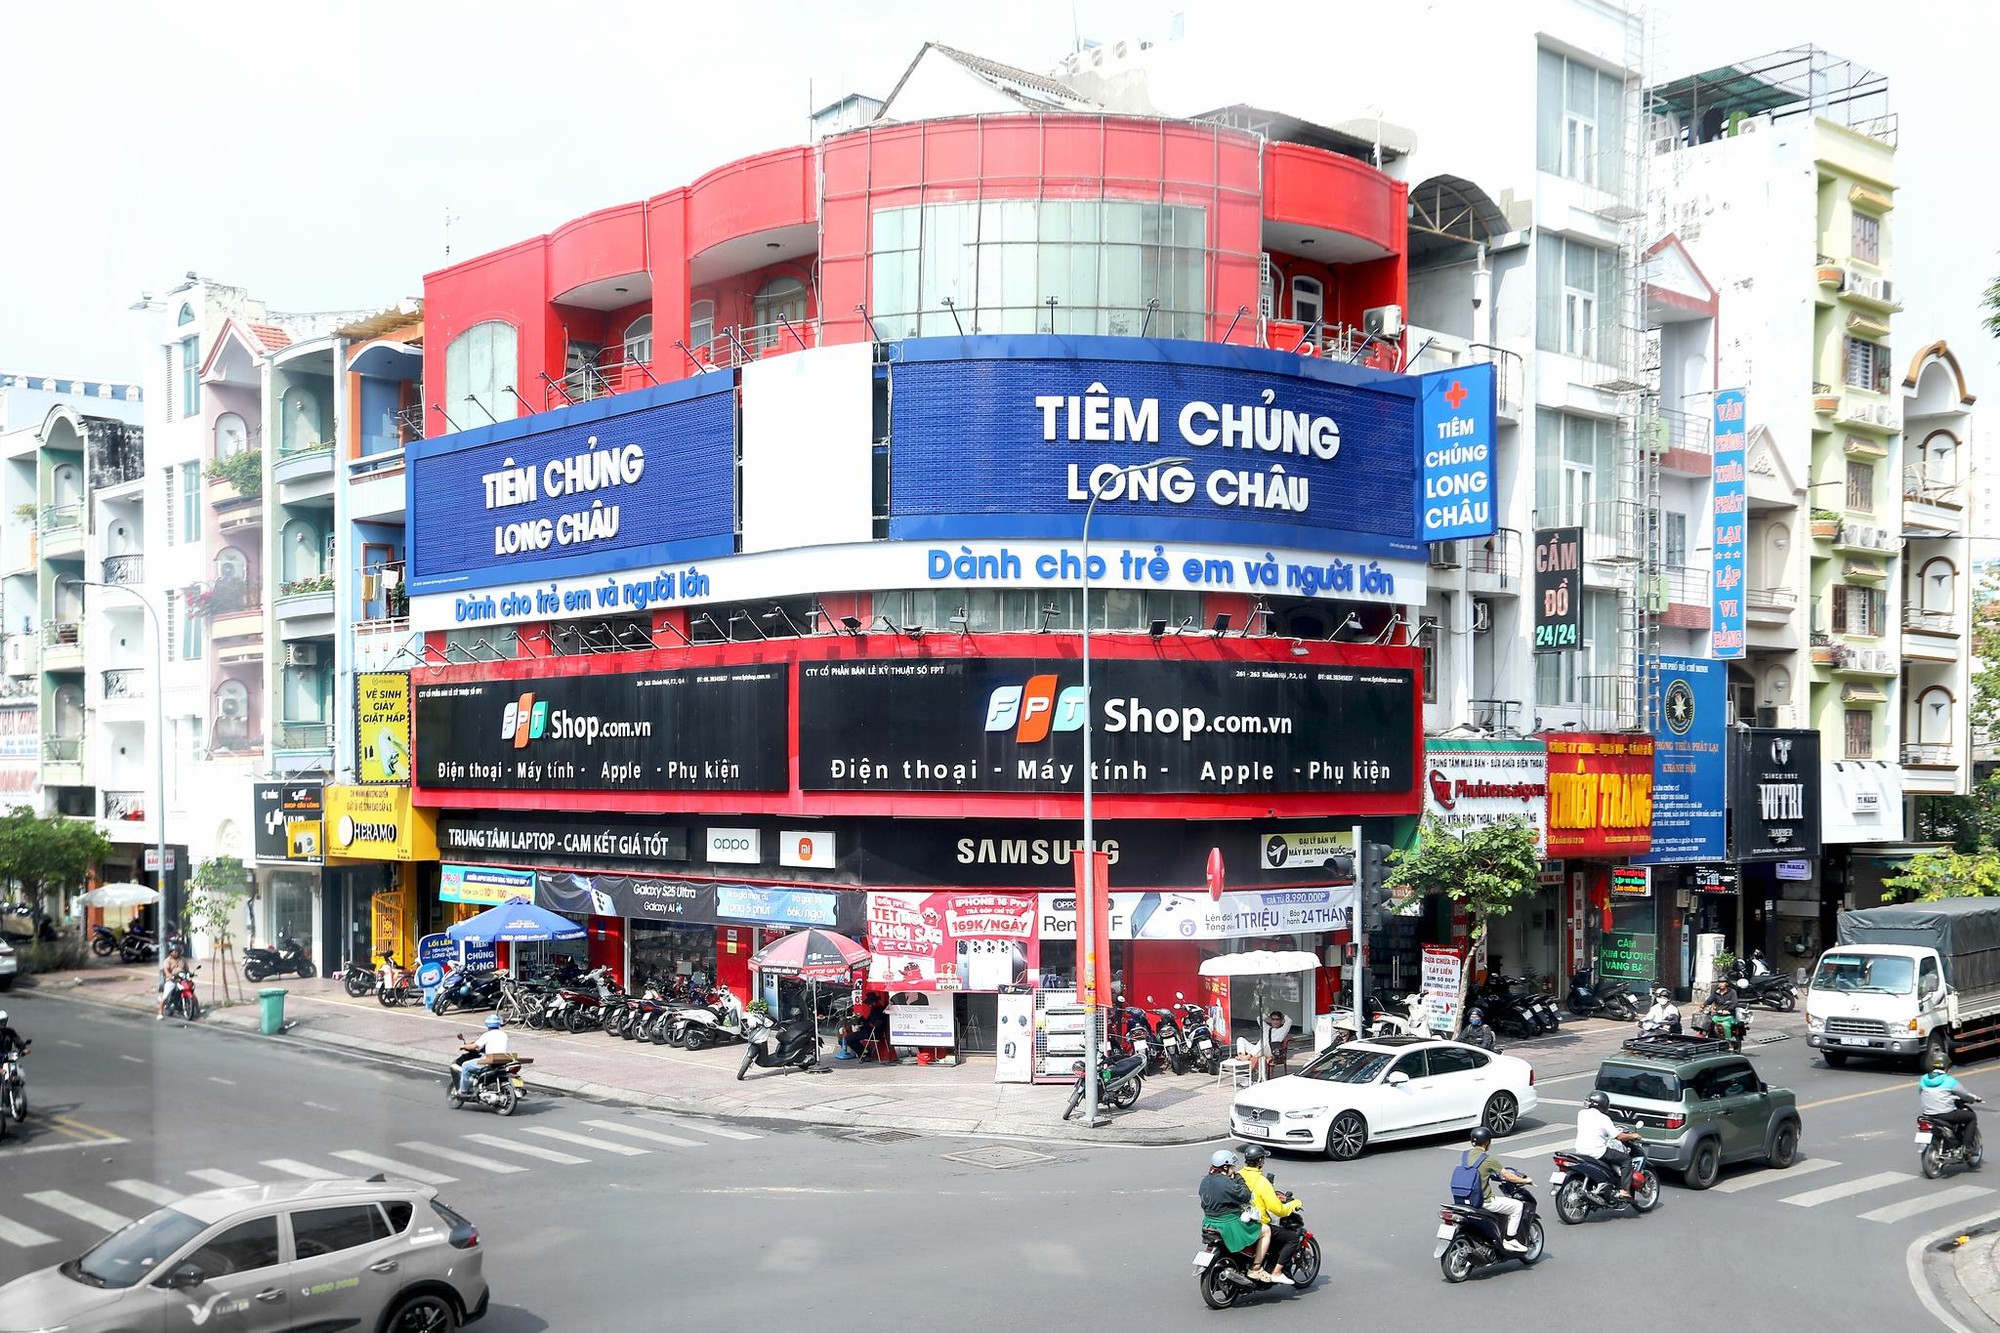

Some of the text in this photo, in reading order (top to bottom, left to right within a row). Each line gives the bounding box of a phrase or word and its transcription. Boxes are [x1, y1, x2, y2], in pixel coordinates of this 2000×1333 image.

[1035, 382, 1341, 460] TIÊM CHỦNG
[1437, 417, 1474, 439] TIÊM
[1425, 442, 1488, 468] CHỦNG
[482, 436, 644, 509] TIÊM CHỦNG
[1067, 463, 1309, 512] LONG CHÂU
[1426, 470, 1488, 499] LONG
[1425, 500, 1489, 529] CHÂU
[495, 500, 619, 555] LONG CHÂU
[928, 545, 1394, 595] Dành cho trẻ em và người lớn
[455, 566, 710, 621] Dành cho trẻ em và người lớn
[1544, 577, 1569, 618] ĐỒ
[1719, 600, 1738, 617] VI
[1536, 624, 1577, 647] 24/24
[805, 668, 818, 676] CTY
[820, 665, 829, 676] CỔ
[831, 665, 850, 675] PHẦN
[851, 666, 865, 675] BÁN
[890, 665, 914, 676] THUẬT
[917, 665, 928, 675] SỐ
[366, 688, 402, 701] VỆ SINH
[373, 700, 395, 711] GIÀY
[363, 711, 406, 725] GIẶT HẤP
[1104, 698, 1292, 741] Shop.com.vn
[551, 709, 651, 745] Shop.com.vn
[438, 759, 739, 784] Điện thoại Máy tính Apple Phụ kiện
[831, 758, 1390, 785] Điện thoại Máy tính Apple Phụ kiện
[1430, 759, 1447, 767] TRUNG
[1449, 757, 1460, 767] TÂM
[1461, 759, 1472, 767] MUA
[1530, 759, 1544, 769] THOẠI
[1601, 773, 1652, 828] TRANG
[354, 823, 397, 842] HERAMO
[1299, 838, 1309, 846] ĐẠI
[1310, 836, 1316, 844] LÝ
[1317, 836, 1328, 844] BÁN
[449, 827, 669, 856] TRUNG TÂM LAPTOP CAM KẾT GIÁ TỐT
[713, 837, 750, 853] oppo
[1289, 847, 1301, 856] MÁY
[1330, 845, 1346, 855] QUỐC
[634, 884, 696, 899] Galaxy S25 Ultra
[643, 902, 667, 914] Galaxy
[955, 897, 1028, 908] IPHONE Pro
[952, 918, 1028, 932] 169K/NGÀY
[1112, 916, 1123, 931] F
[1205, 914, 1221, 922] Lên
[1301, 910, 1314, 924] 24
[428, 940, 439, 948] LỐI
[467, 948, 494, 960] CHỦNG
[1602, 950, 1617, 959] KIM
[1605, 960, 1630, 970] VÀNG
